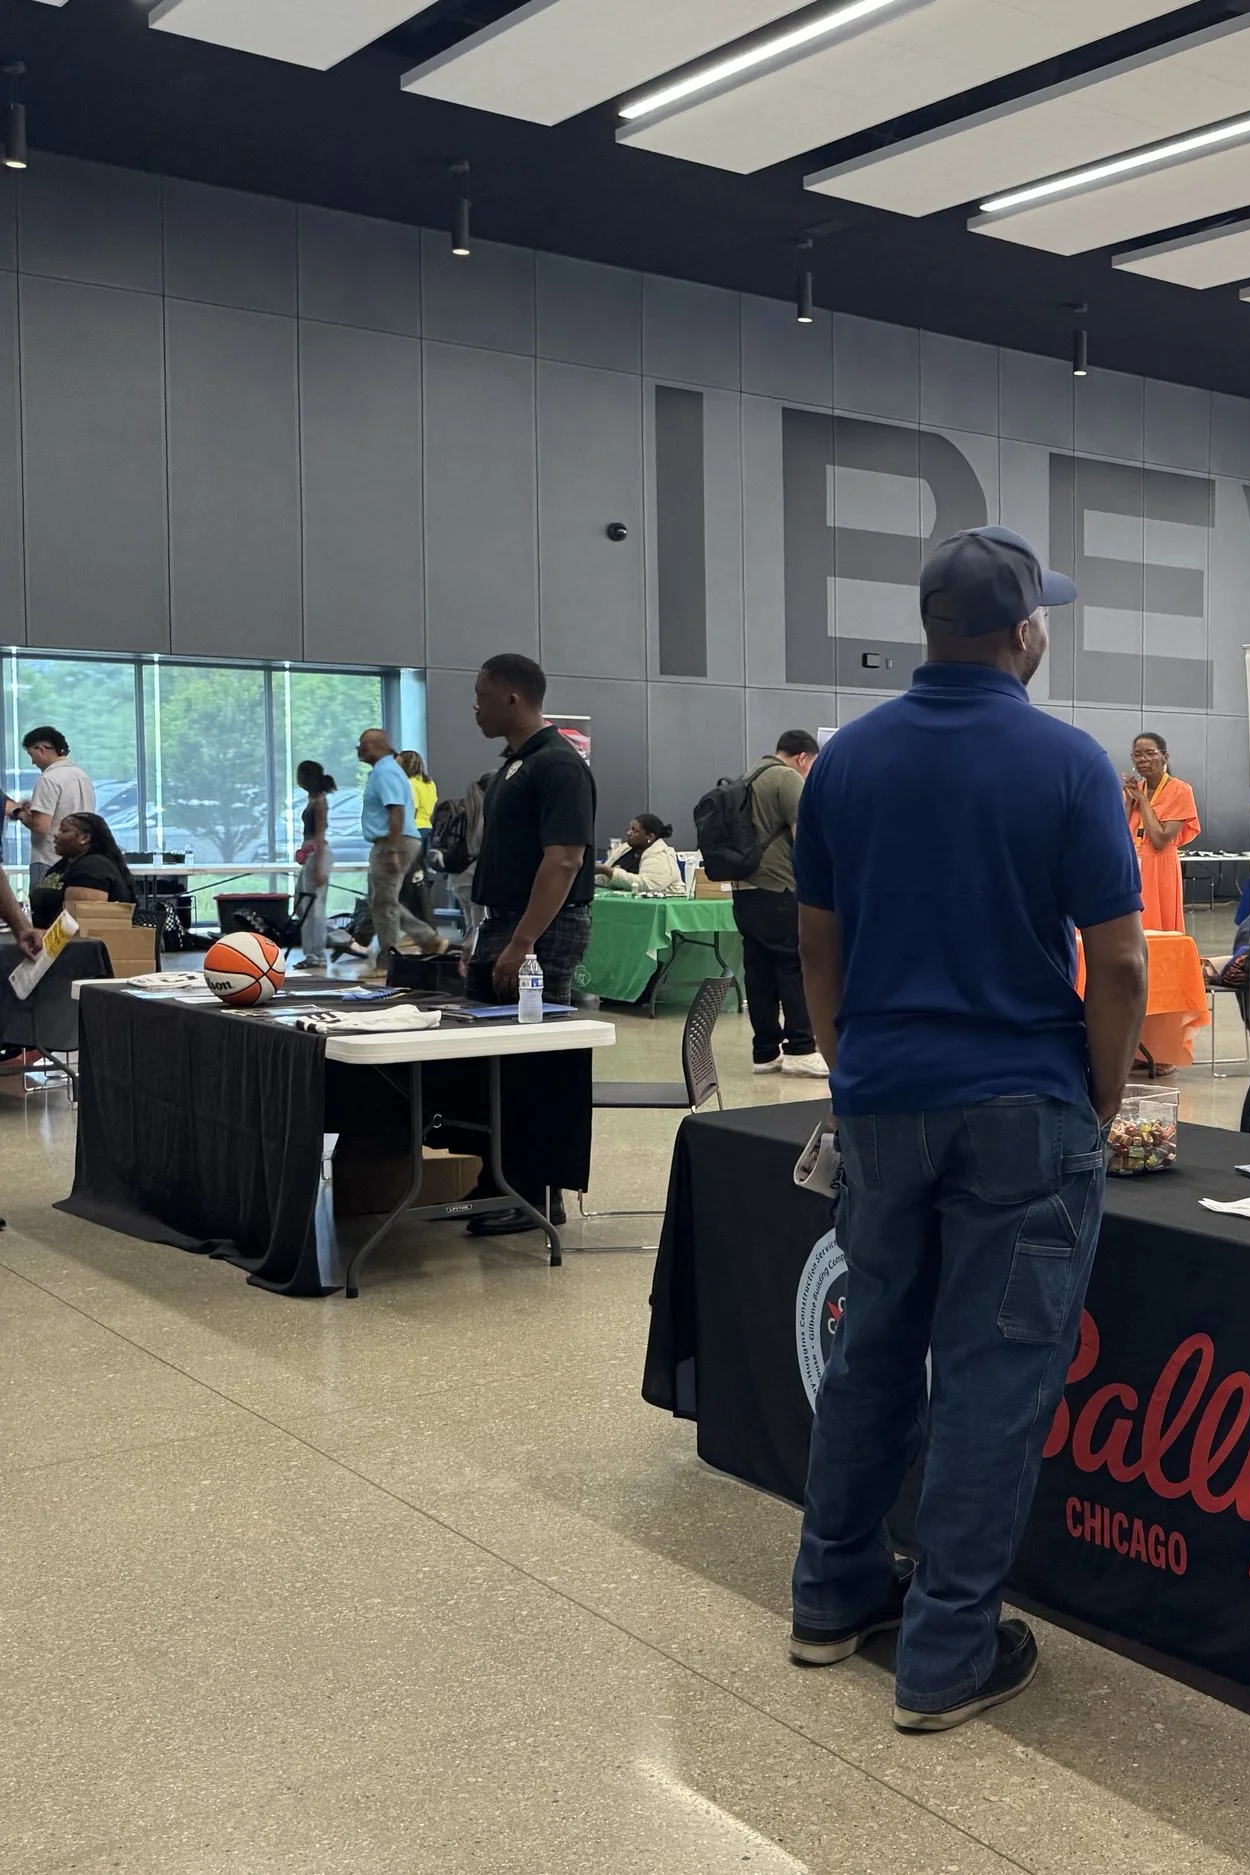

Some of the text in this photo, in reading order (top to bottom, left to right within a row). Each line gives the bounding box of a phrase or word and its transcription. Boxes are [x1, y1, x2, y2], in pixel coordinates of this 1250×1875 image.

[206, 977, 233, 990] lson
[828, 1252, 846, 1270] Comp
[800, 1262, 819, 1328] Construction
[814, 1240, 838, 1264] Service
[812, 1267, 830, 1302] Building
[808, 1302, 817, 1341] Gilbane
[1065, 1496, 1187, 1575] CHICAGO
